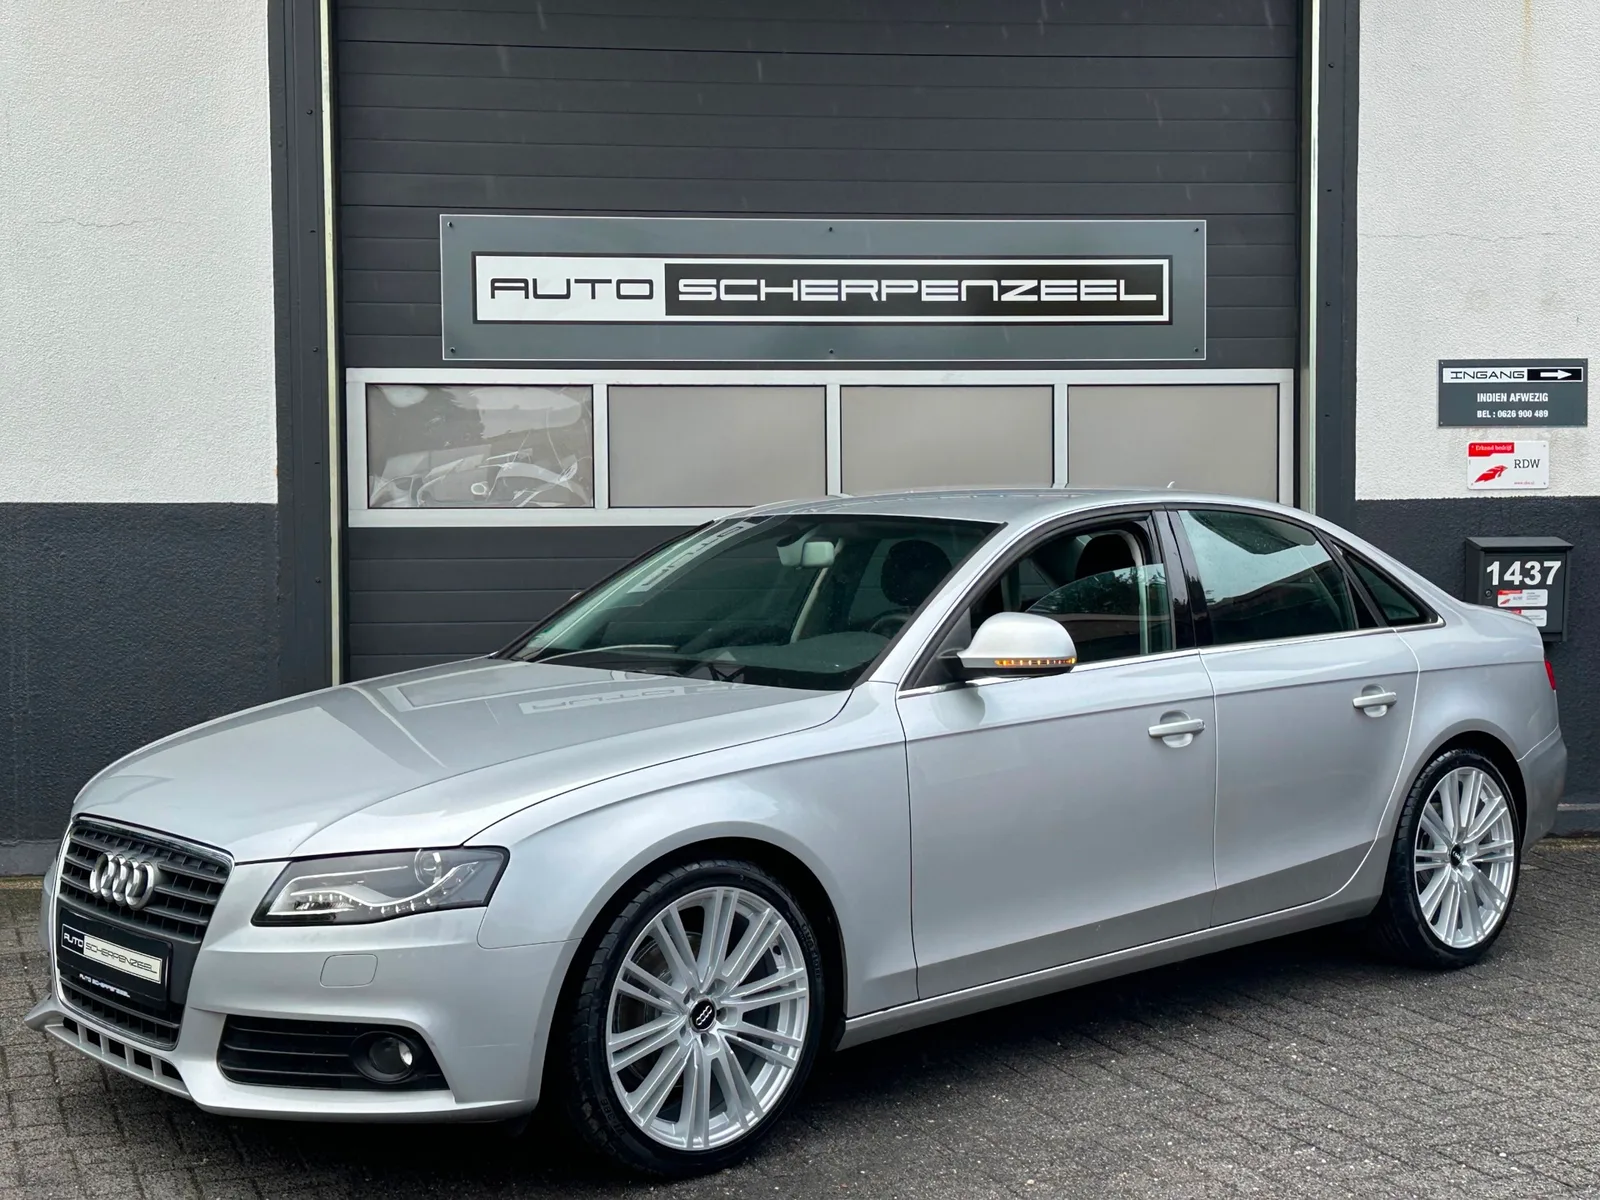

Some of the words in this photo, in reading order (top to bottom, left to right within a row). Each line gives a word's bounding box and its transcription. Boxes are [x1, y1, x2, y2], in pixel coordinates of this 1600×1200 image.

[490, 278, 654, 300] AUTO
[678, 278, 1157, 302] SCHERPENZEEL
[1450, 371, 1525, 380] INGANG
[1477, 392, 1507, 402] INDIEN
[1509, 392, 1549, 402] AFWEZIG
[1477, 410, 1492, 418] BEL
[1518, 410, 1533, 418] 900
[1514, 459, 1540, 468] RDW
[1486, 561, 1561, 585] 1437
[63, 932, 84, 948] AUTO
